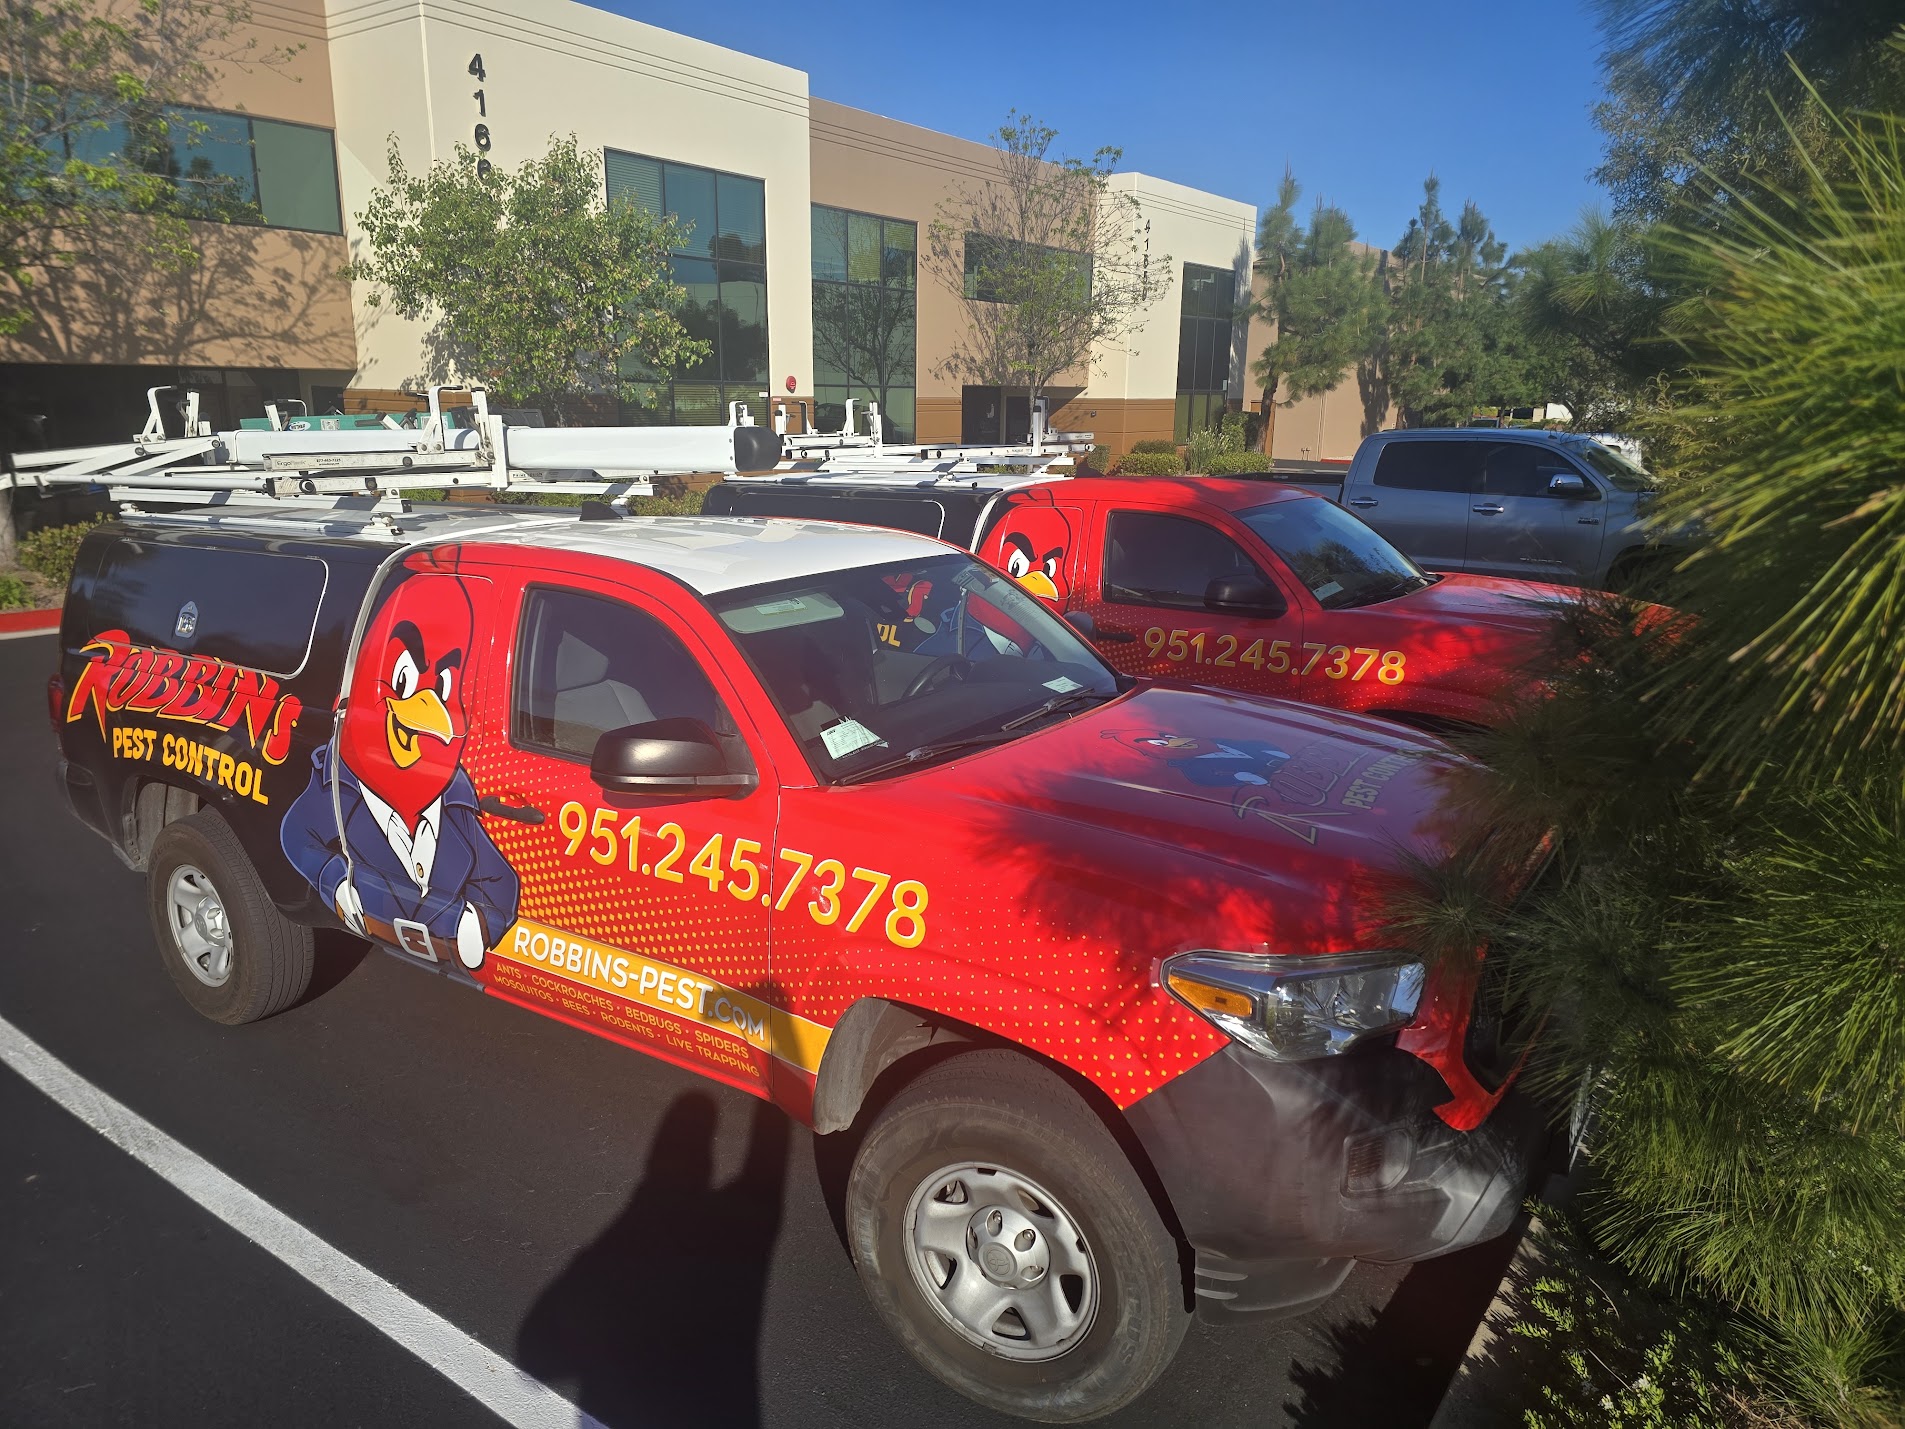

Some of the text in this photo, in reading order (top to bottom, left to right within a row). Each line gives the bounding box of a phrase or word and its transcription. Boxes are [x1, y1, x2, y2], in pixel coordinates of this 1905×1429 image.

[66, 629, 303, 766] ROBBINS
[1144, 626, 1407, 685] 951.245.7378
[112, 727, 269, 806] PEST CONTROL
[1341, 748, 1424, 810] PEST CONTRO
[559, 801, 929, 949] 951.245.7378
[493, 974, 760, 1078] MOSQUITOS BEES RODENTS LIVE TRAPPING
[496, 962, 749, 1060] ANTS COCKROACHES BEDBUGS SPIDERS
[514, 926, 765, 1042] ROBBINS-PEST.COM
